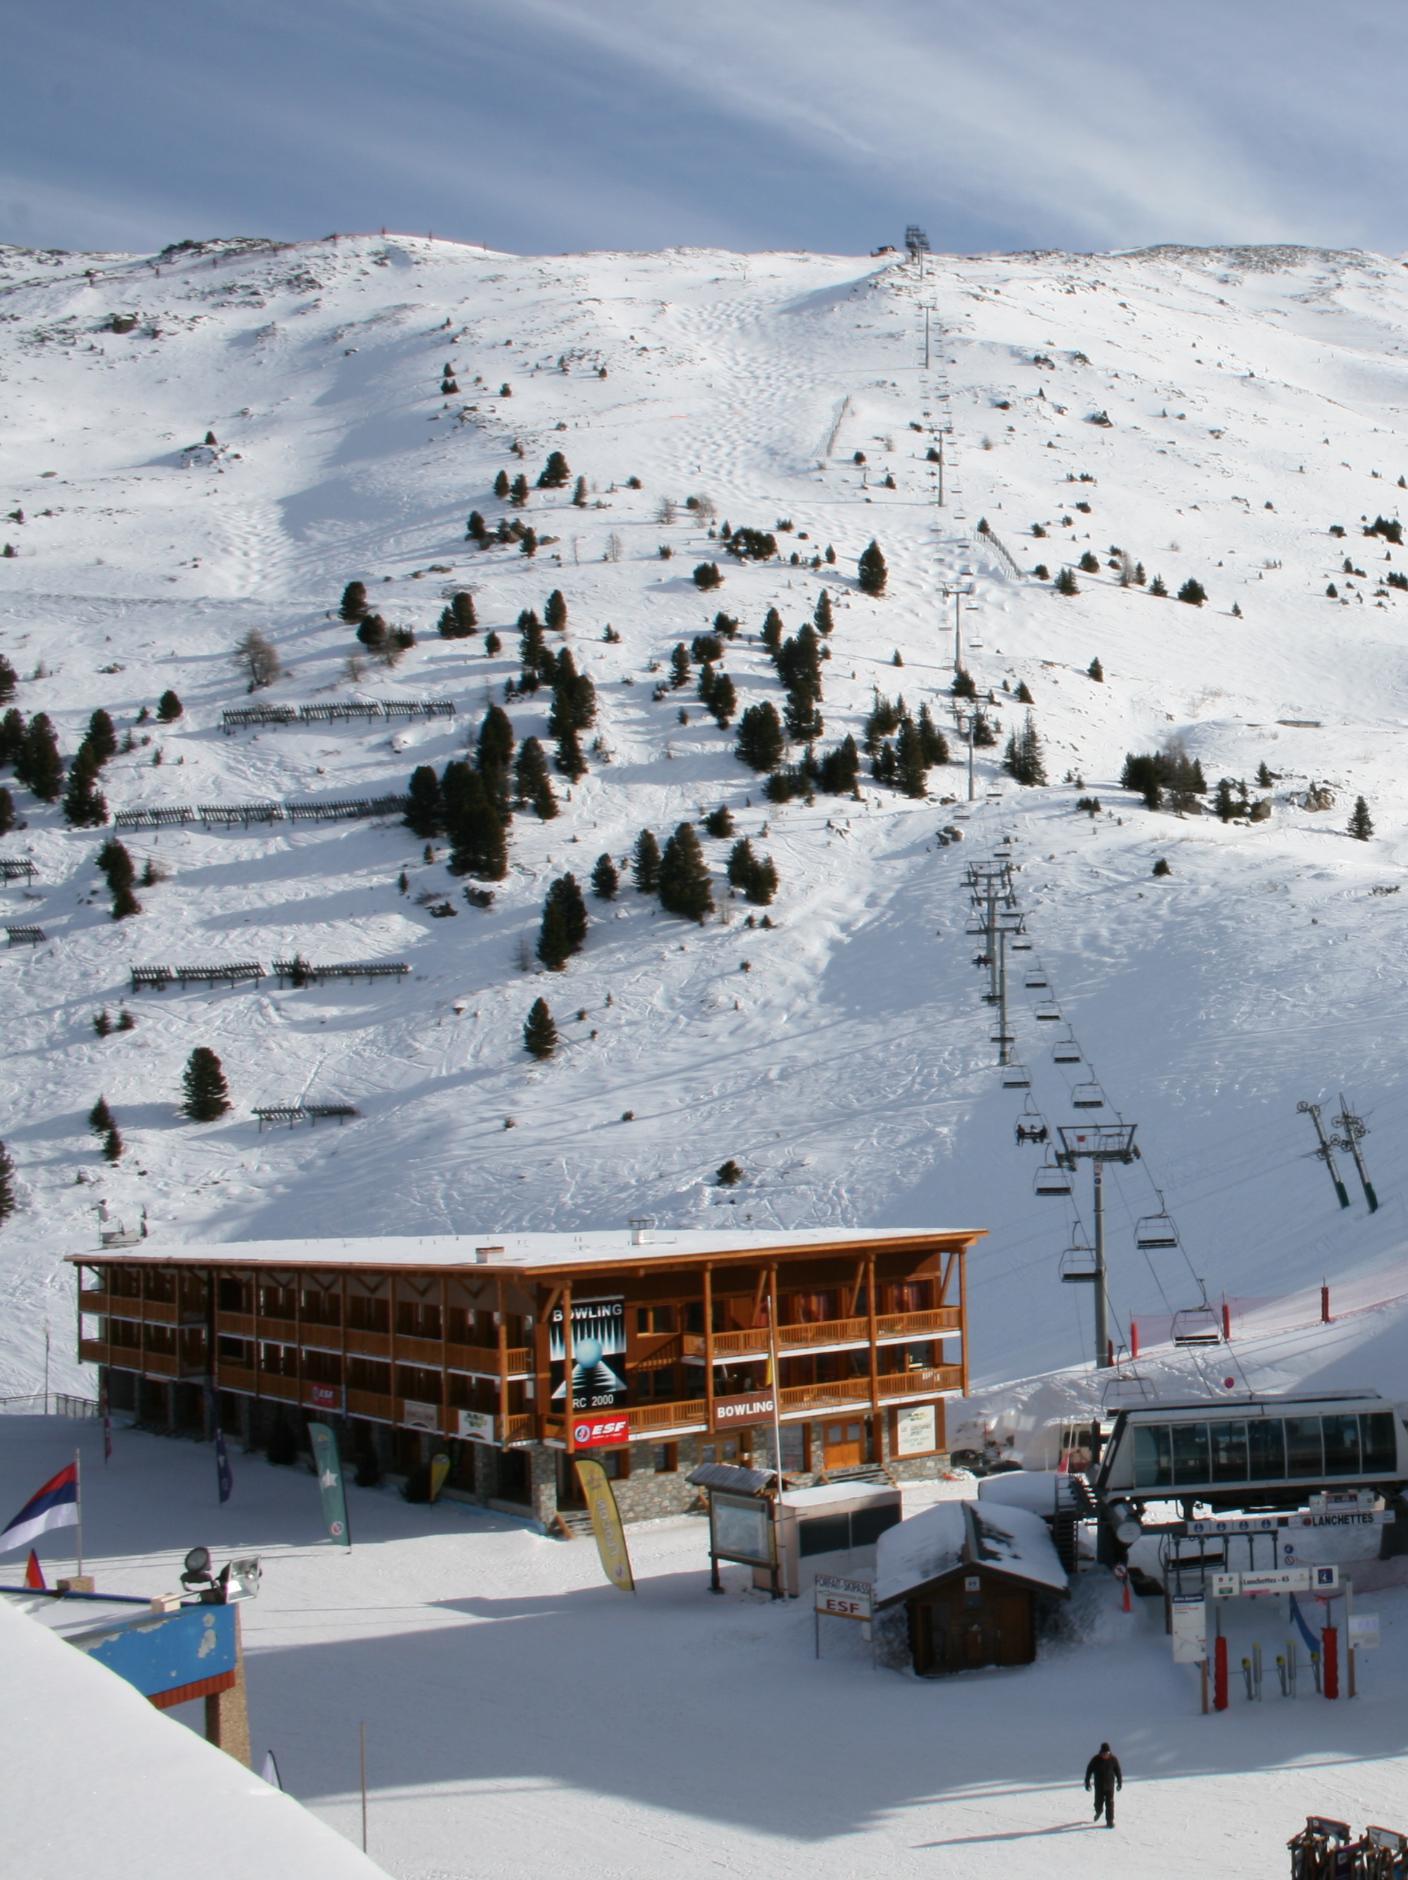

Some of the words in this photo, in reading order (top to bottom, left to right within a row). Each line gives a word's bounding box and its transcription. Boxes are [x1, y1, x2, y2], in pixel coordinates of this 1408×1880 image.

[591, 1394, 614, 1407] 2000
[717, 1400, 774, 1418] BOWLING
[591, 1421, 627, 1435] ESF
[1312, 1512, 1375, 1527] LANCHETTES
[826, 1599, 860, 1614] ESF
